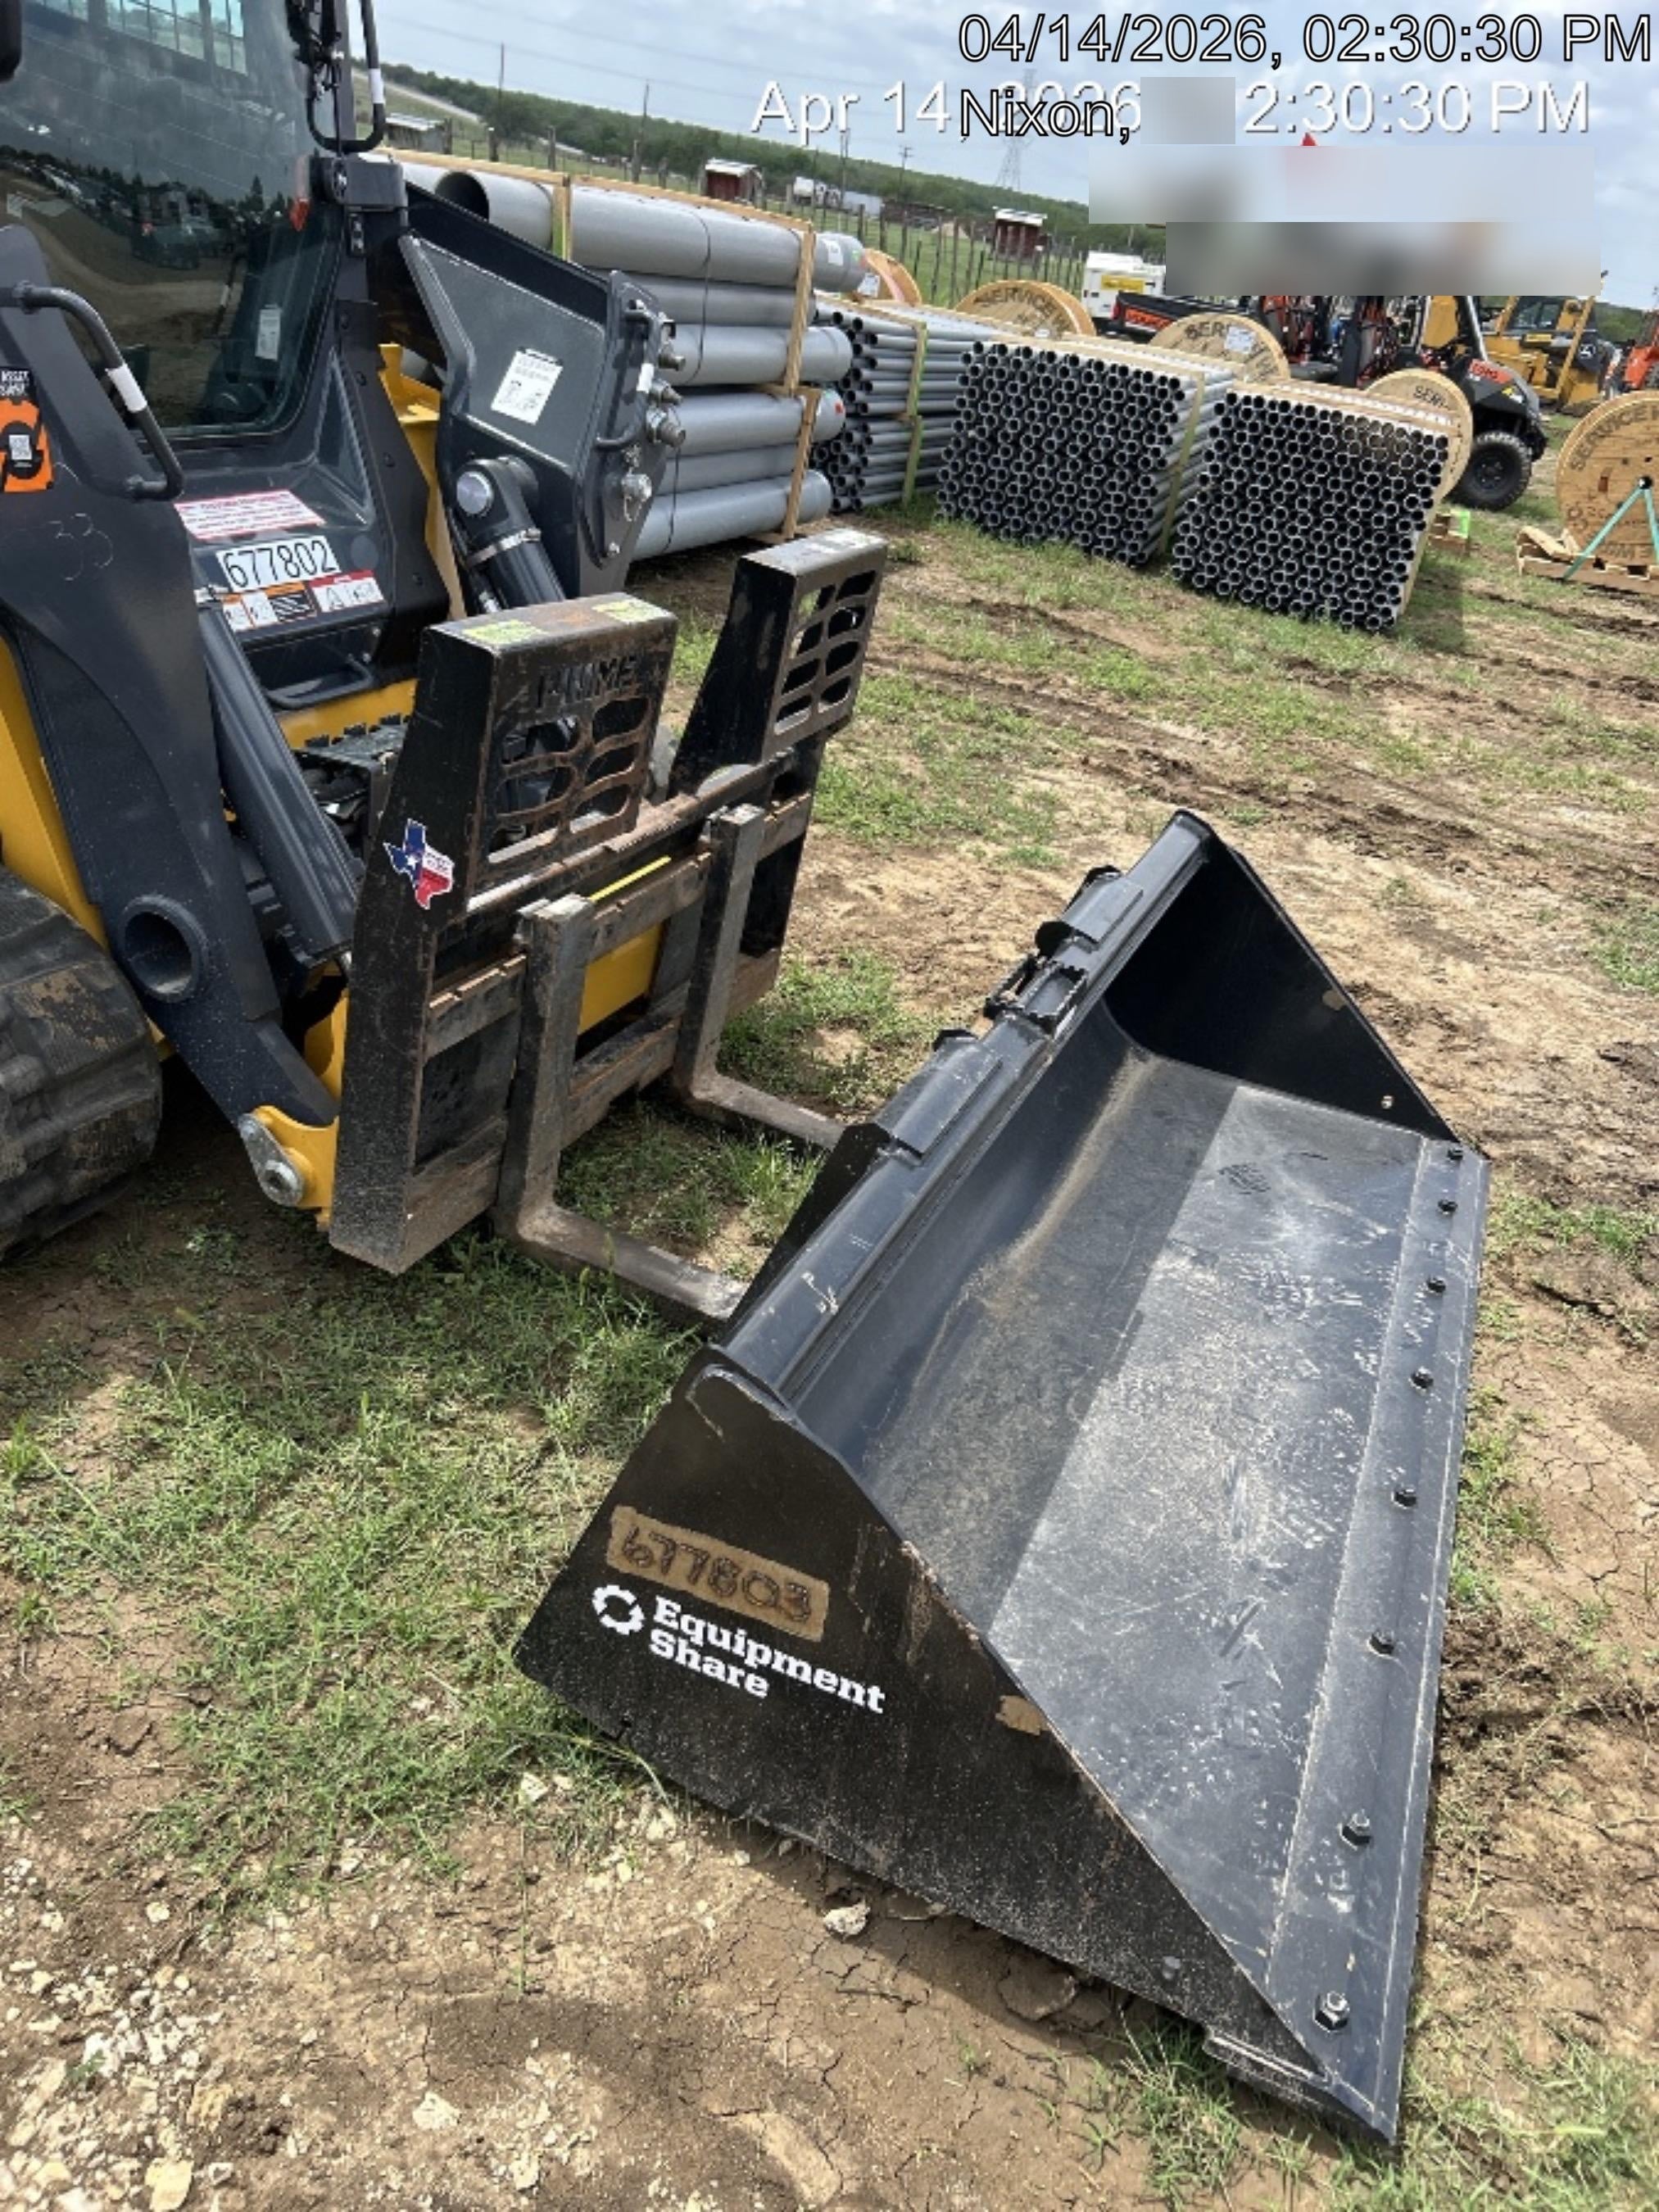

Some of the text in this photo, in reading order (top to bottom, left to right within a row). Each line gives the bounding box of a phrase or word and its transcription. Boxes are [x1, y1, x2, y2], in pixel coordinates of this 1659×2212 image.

[224, 541, 336, 587] 677802
[623, 1526, 812, 1623] 677803
[650, 1628, 770, 1699] Share
[654, 1596, 886, 1714] Equipment
